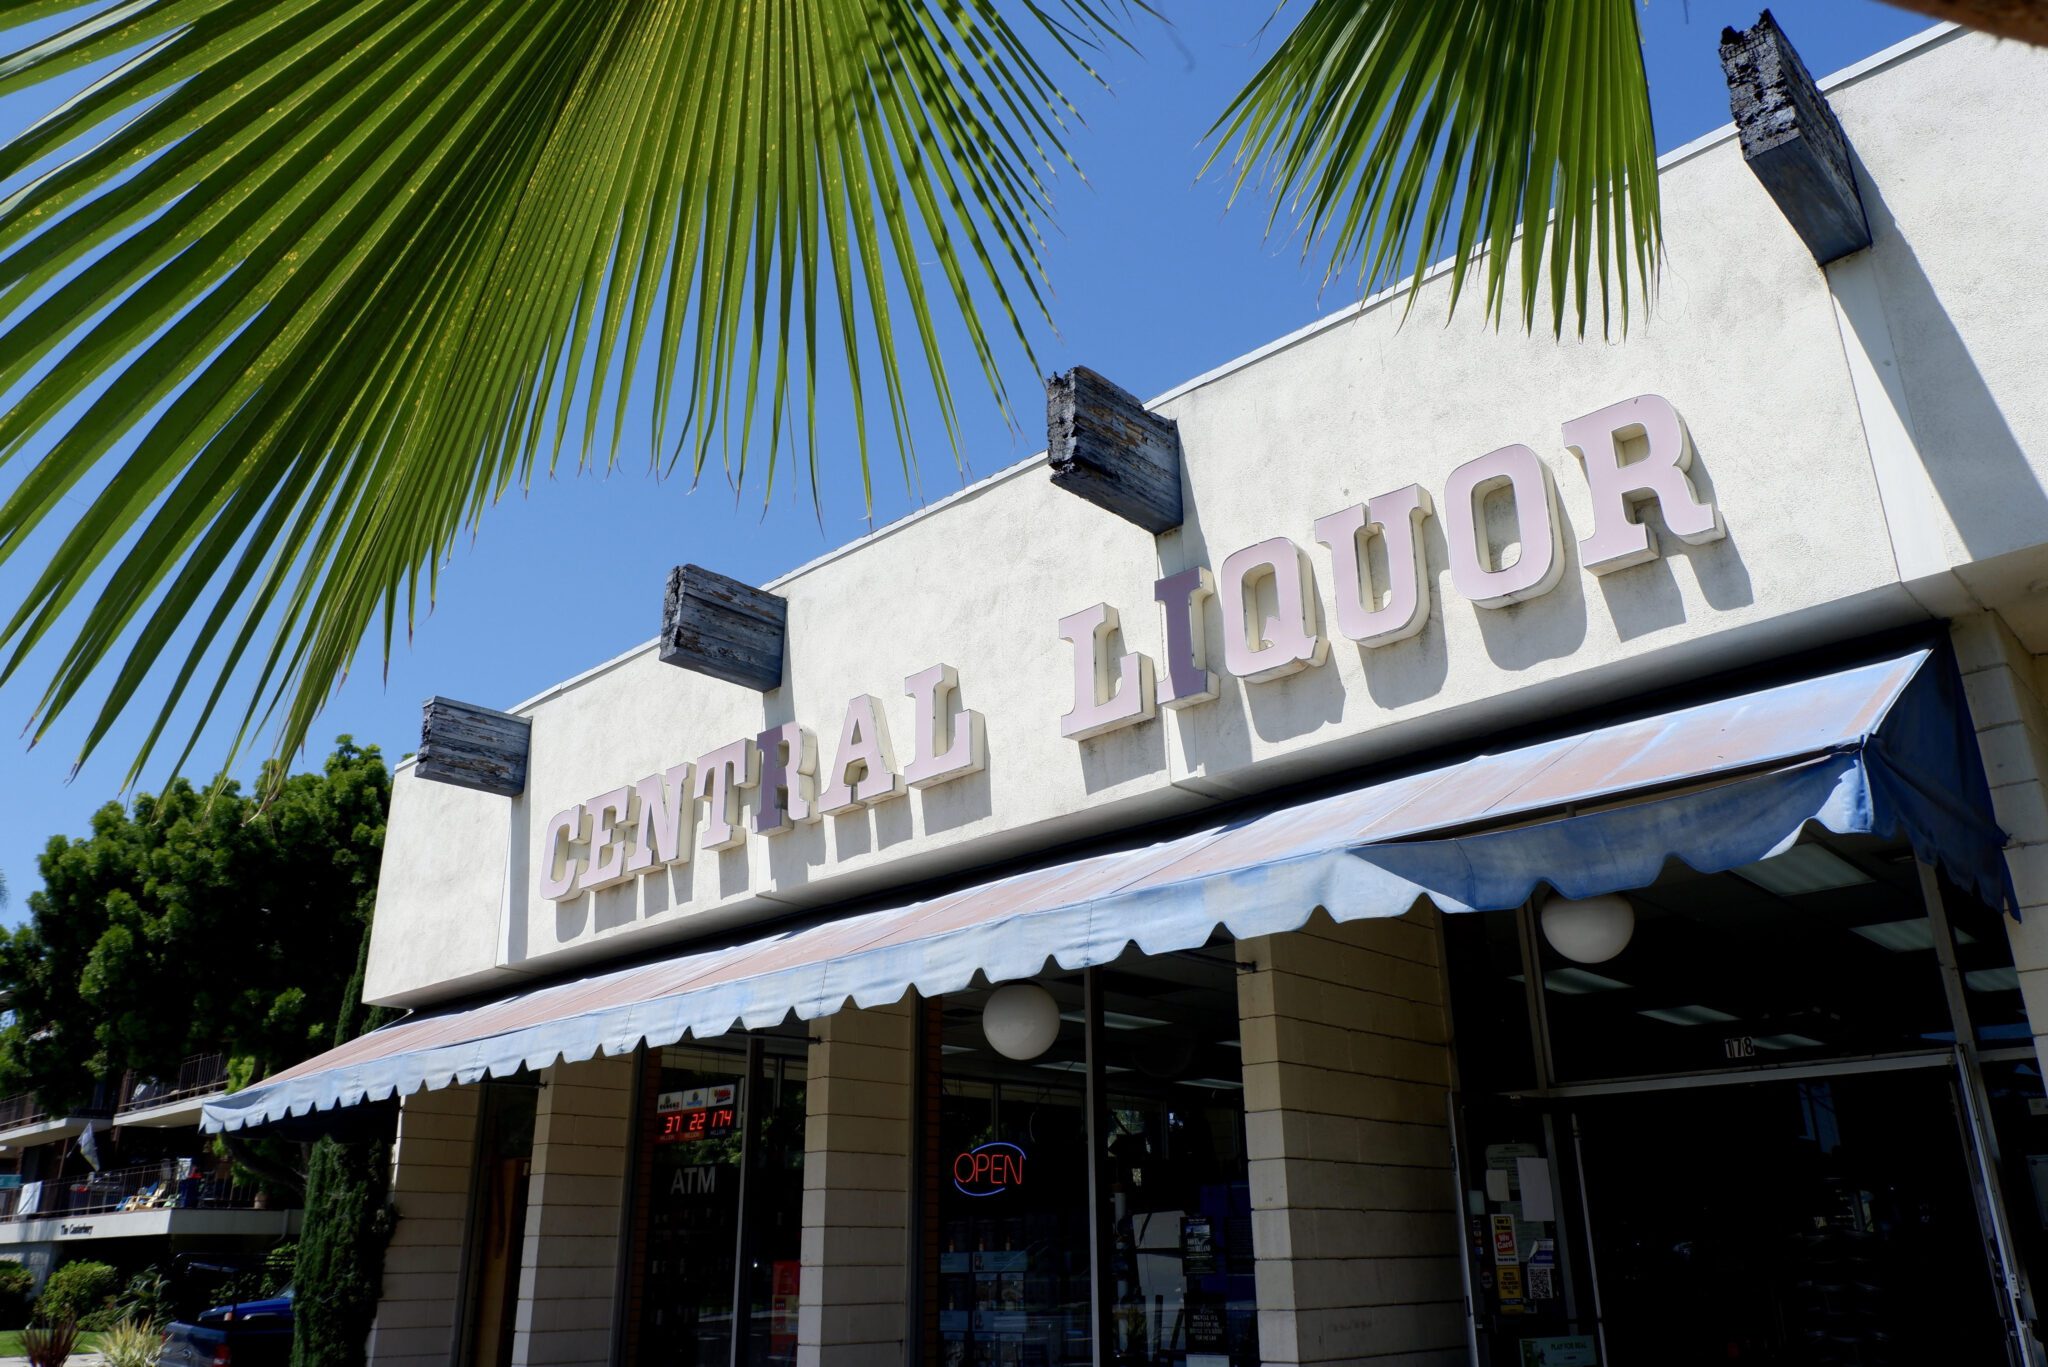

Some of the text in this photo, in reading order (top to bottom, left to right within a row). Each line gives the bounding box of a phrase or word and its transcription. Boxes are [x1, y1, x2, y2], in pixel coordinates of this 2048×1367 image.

[540, 394, 1725, 902] CENTRAL LIQUOR
[1725, 1037, 1755, 1058] 178
[664, 1115, 681, 1134] 37
[689, 1112, 706, 1130] 22
[712, 1110, 732, 1127] 174
[954, 1152, 1023, 1185] OPEN
[669, 1166, 716, 1195] ATM
